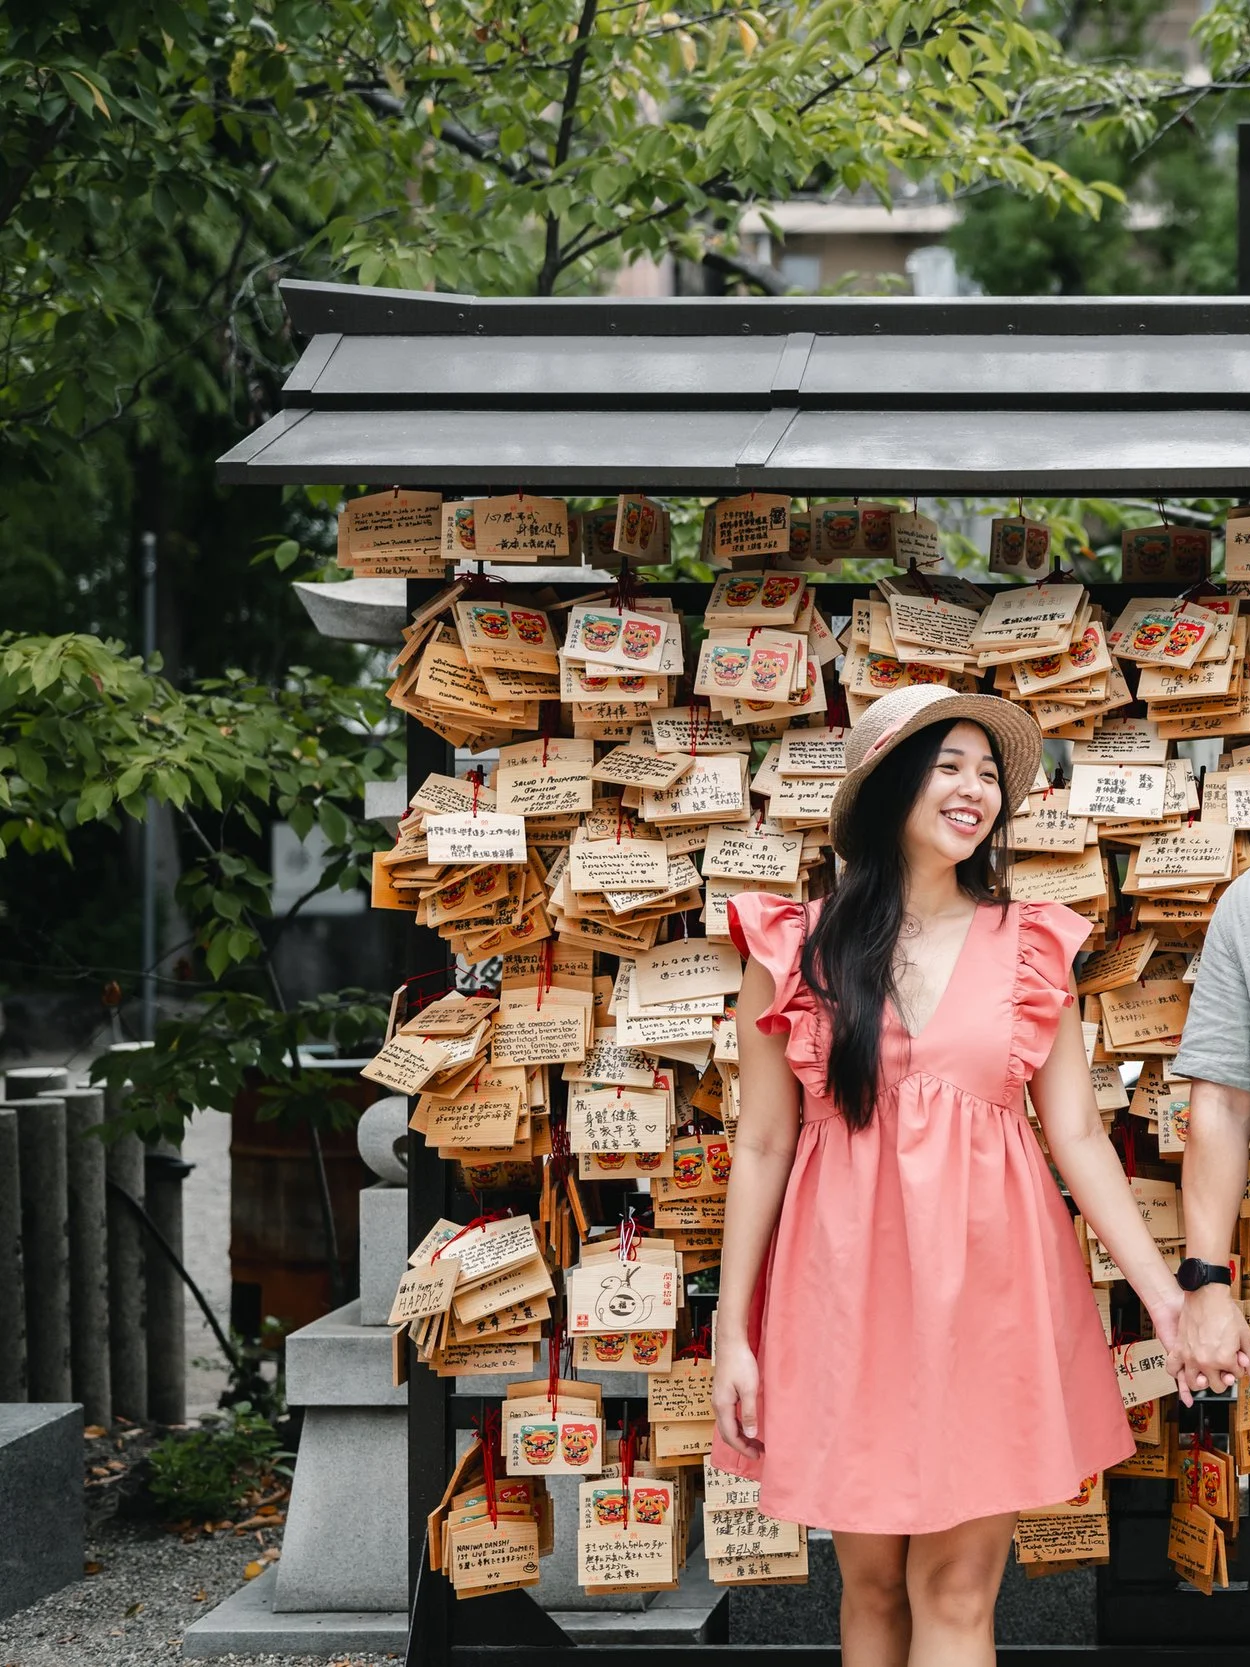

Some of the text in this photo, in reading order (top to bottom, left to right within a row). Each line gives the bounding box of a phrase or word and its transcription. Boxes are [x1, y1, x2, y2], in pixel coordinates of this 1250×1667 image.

[651, 954, 719, 969] みんなが幸せに
[456, 1539, 510, 1552] NANIWA DANSHI
